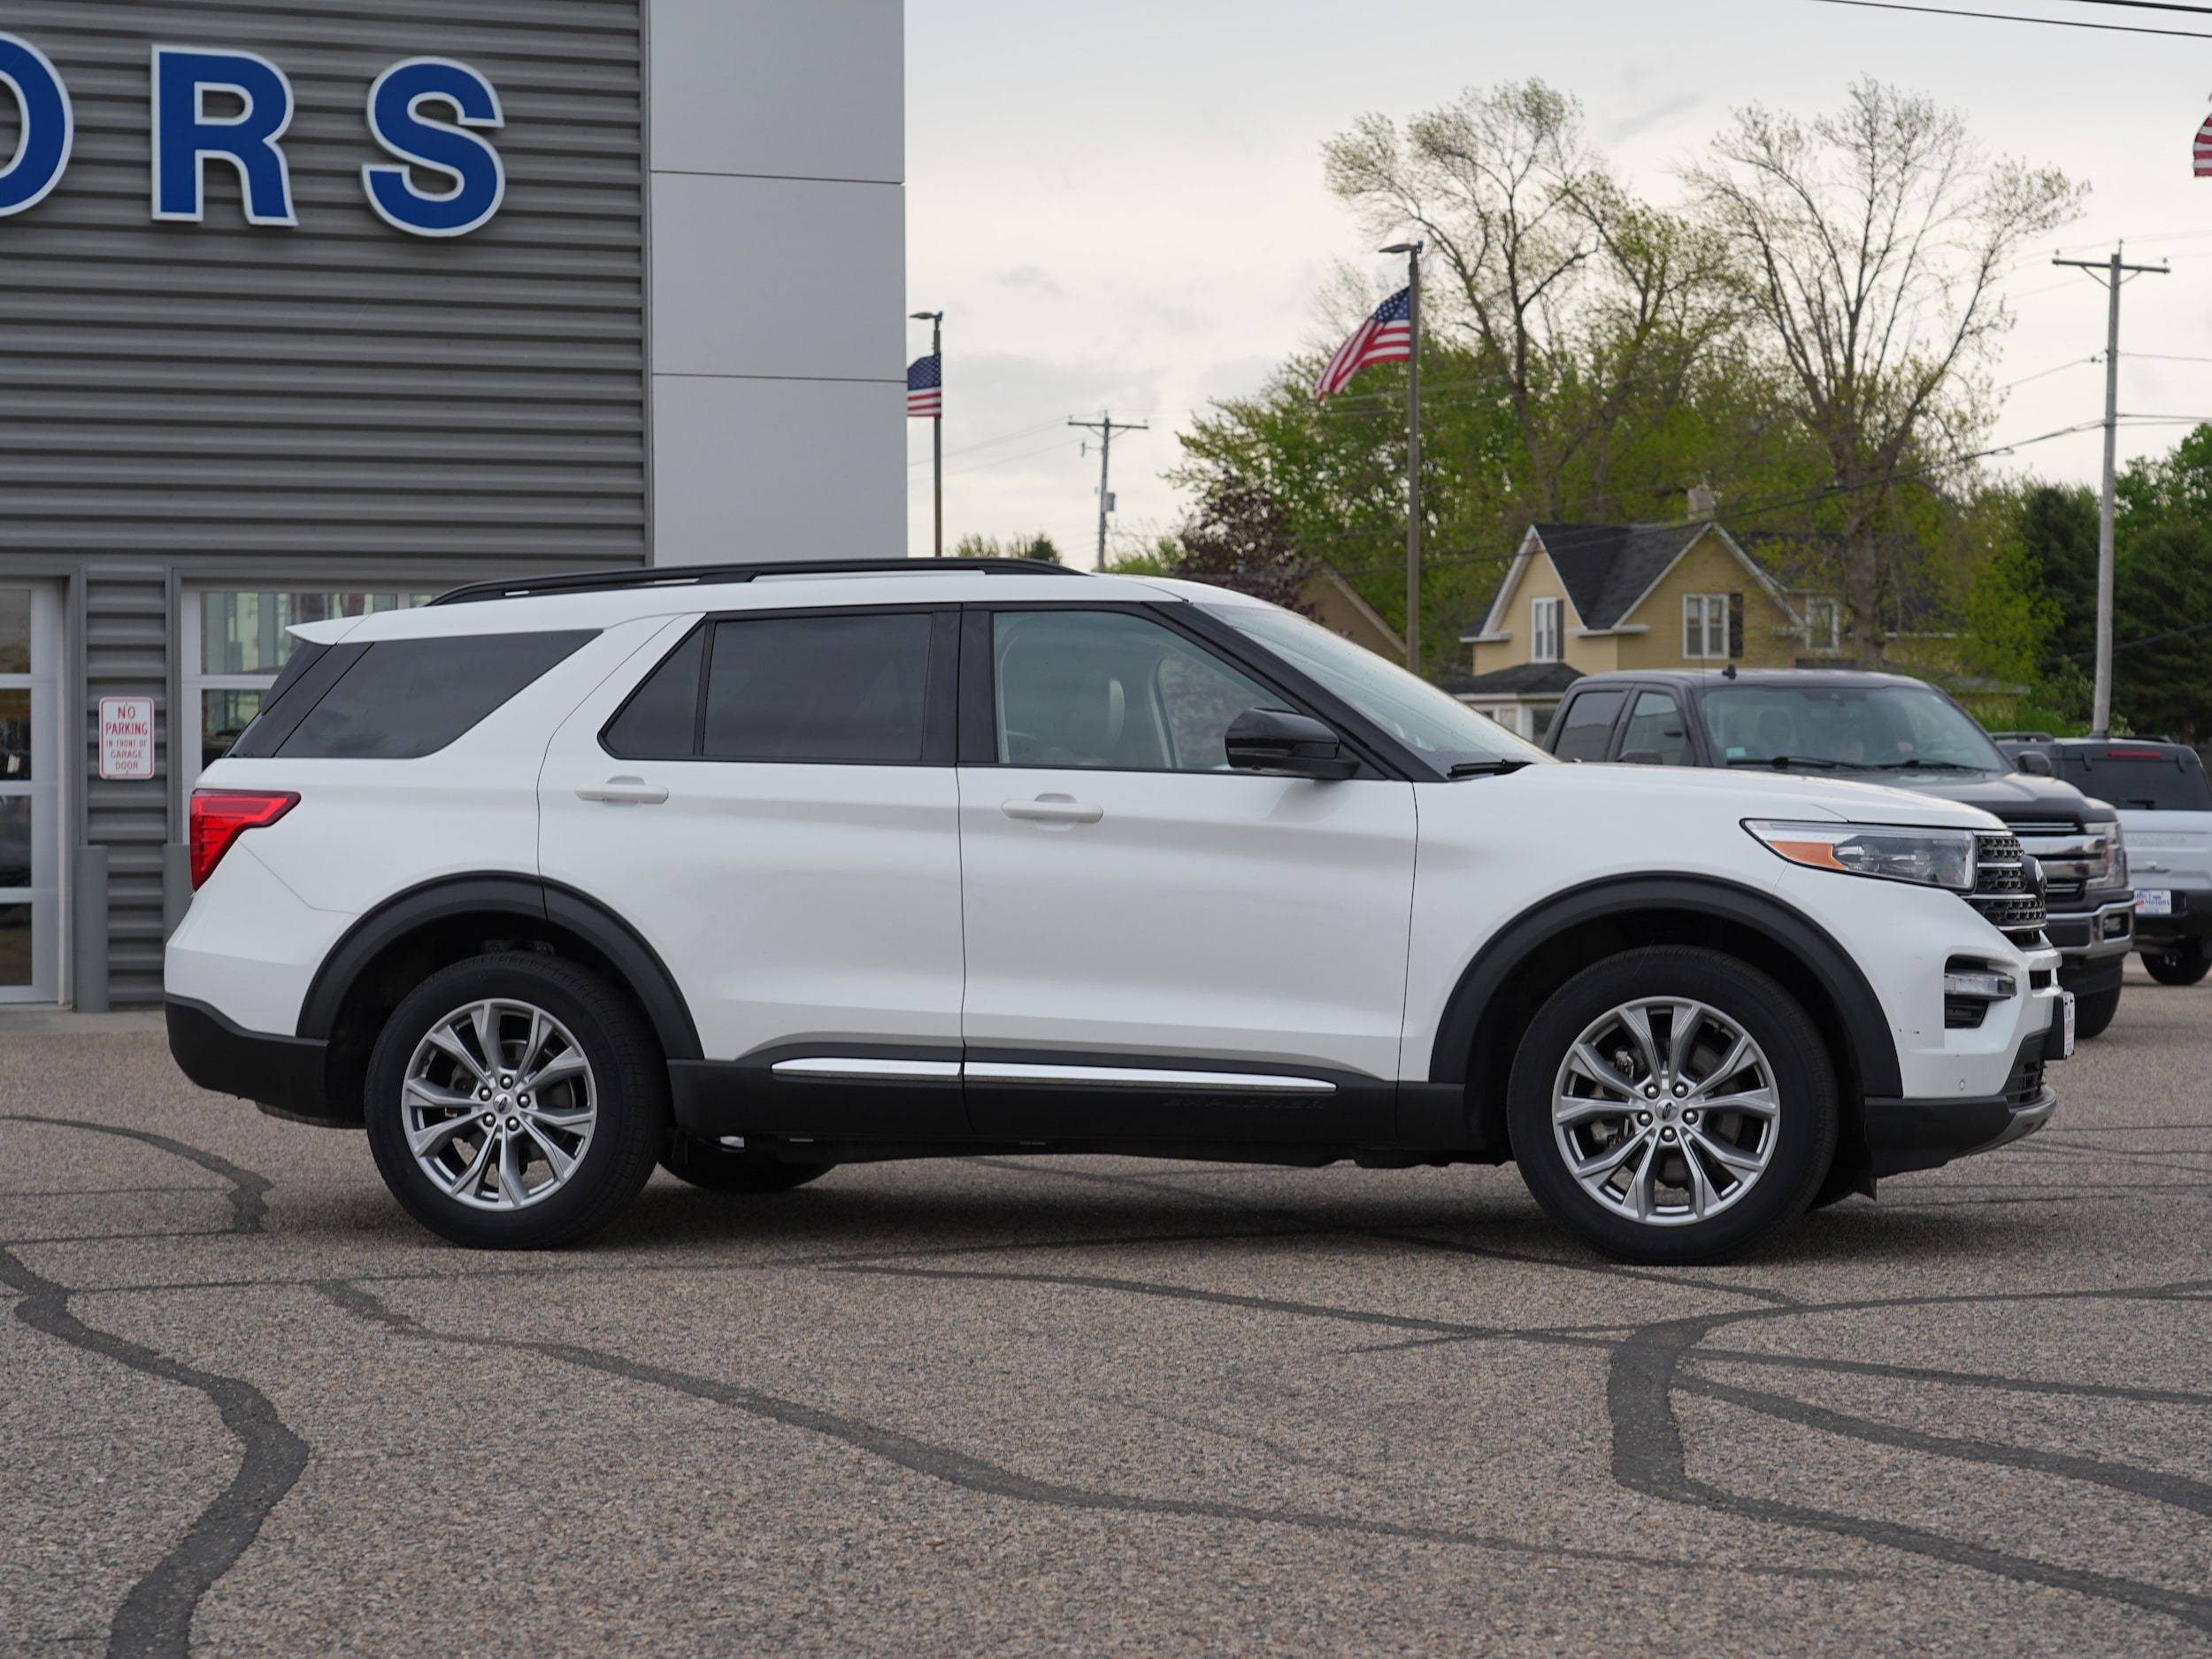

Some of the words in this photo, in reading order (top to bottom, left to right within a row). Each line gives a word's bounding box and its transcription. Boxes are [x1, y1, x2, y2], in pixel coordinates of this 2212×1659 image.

[118, 706, 135, 718] NO
[106, 722, 148, 734] PARKING
[115, 761, 139, 770] DOOR
